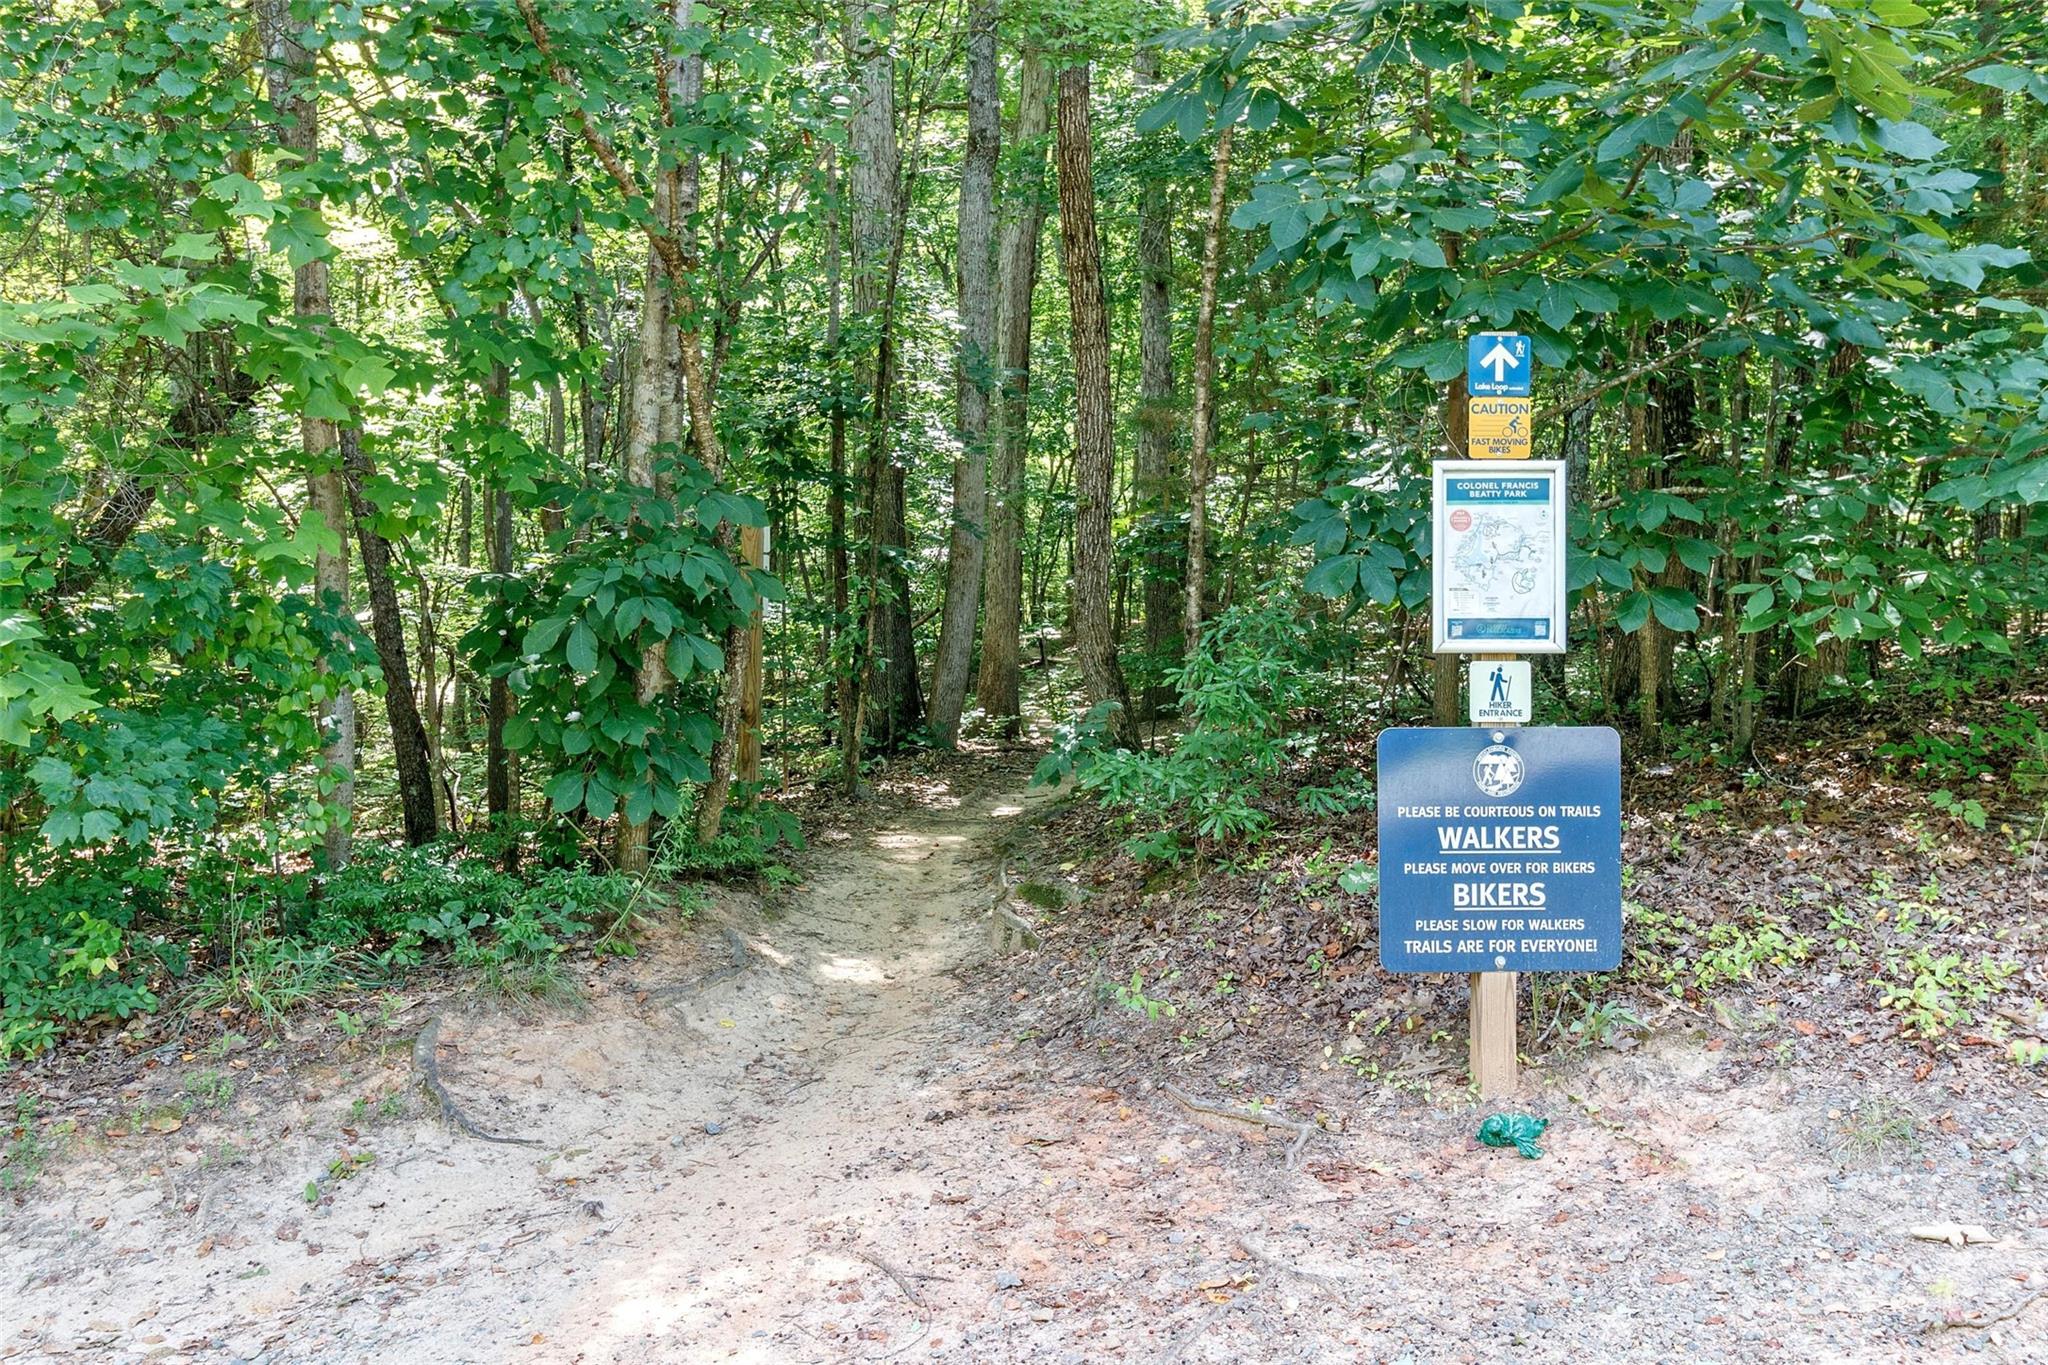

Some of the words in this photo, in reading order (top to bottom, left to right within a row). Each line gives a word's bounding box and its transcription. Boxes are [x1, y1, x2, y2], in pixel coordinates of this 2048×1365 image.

[1492, 383, 1508, 392] Loop
[1471, 404, 1529, 414] CAUTION
[1492, 438, 1528, 446] MOVING
[1456, 482, 1499, 490] COLONEL
[1479, 709, 1522, 717] ENTRANCE
[1397, 806, 1441, 817] PLEASE
[1445, 806, 1459, 817] BE
[1464, 806, 1534, 817] COURTEOUS
[1539, 806, 1556, 817] ON
[1560, 805, 1601, 817] TRAILS
[1437, 826, 1560, 849] WALKERS
[1404, 863, 1447, 874] PLEASE
[1451, 863, 1486, 874] MOVE
[1490, 863, 1521, 874] OVER
[1526, 863, 1549, 873] FOR
[1553, 862, 1595, 873] BIKERS
[1453, 883, 1546, 906] BIKERS
[1415, 920, 1458, 931] PLEASE
[1462, 920, 1497, 931] SLOW
[1502, 919, 1524, 930] FOR
[1528, 919, 1585, 930] WALKERS
[1404, 940, 1452, 953] TRAILS
[1457, 940, 1484, 953] ARE
[1489, 940, 1516, 952] FOR
[1521, 939, 1598, 952] EVERYONE!
